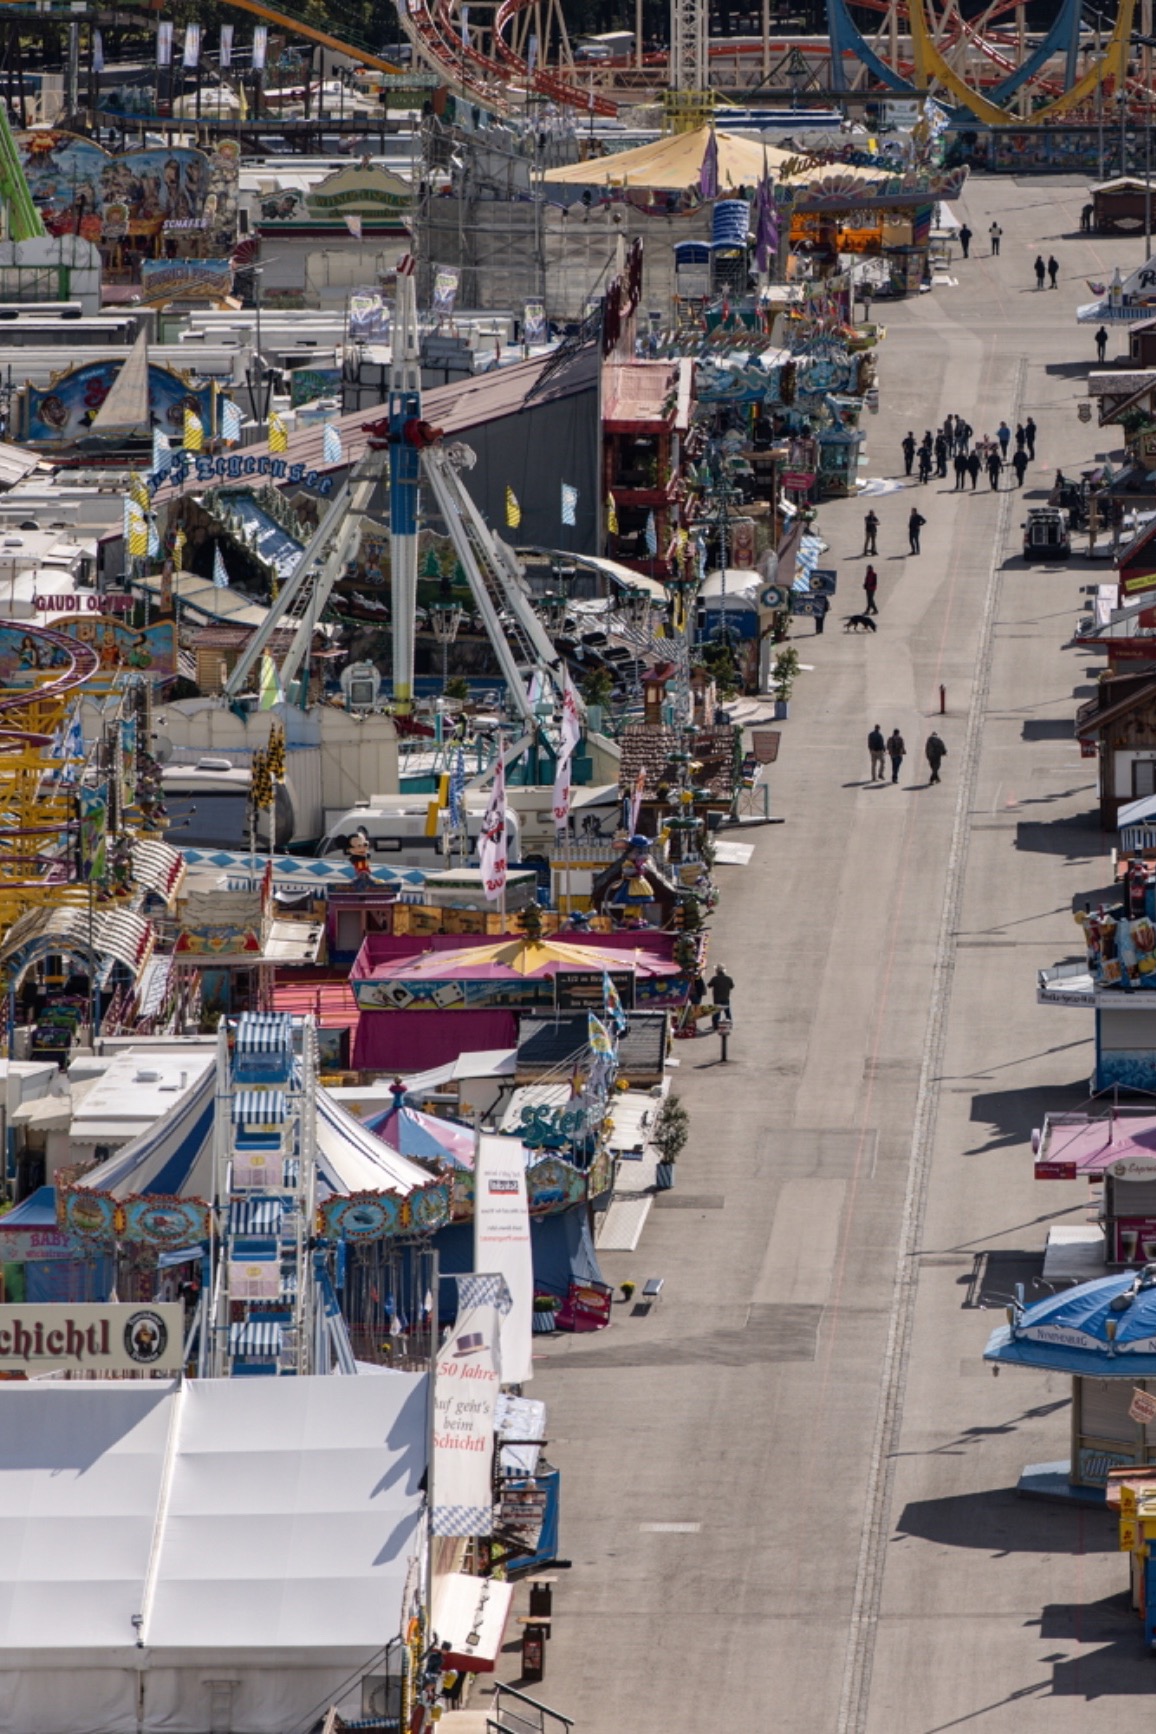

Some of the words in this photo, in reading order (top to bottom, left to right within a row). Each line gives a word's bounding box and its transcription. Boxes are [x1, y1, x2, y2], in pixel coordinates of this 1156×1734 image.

[35, 596, 83, 611] GAUDI
[30, 1233, 71, 1247] BABY
[1037, 1329, 1088, 1346] NYMPHENBURG
[460, 1362, 498, 1381] Jahre
[456, 1399, 489, 1415] geht's
[442, 1416, 473, 1432] beim
